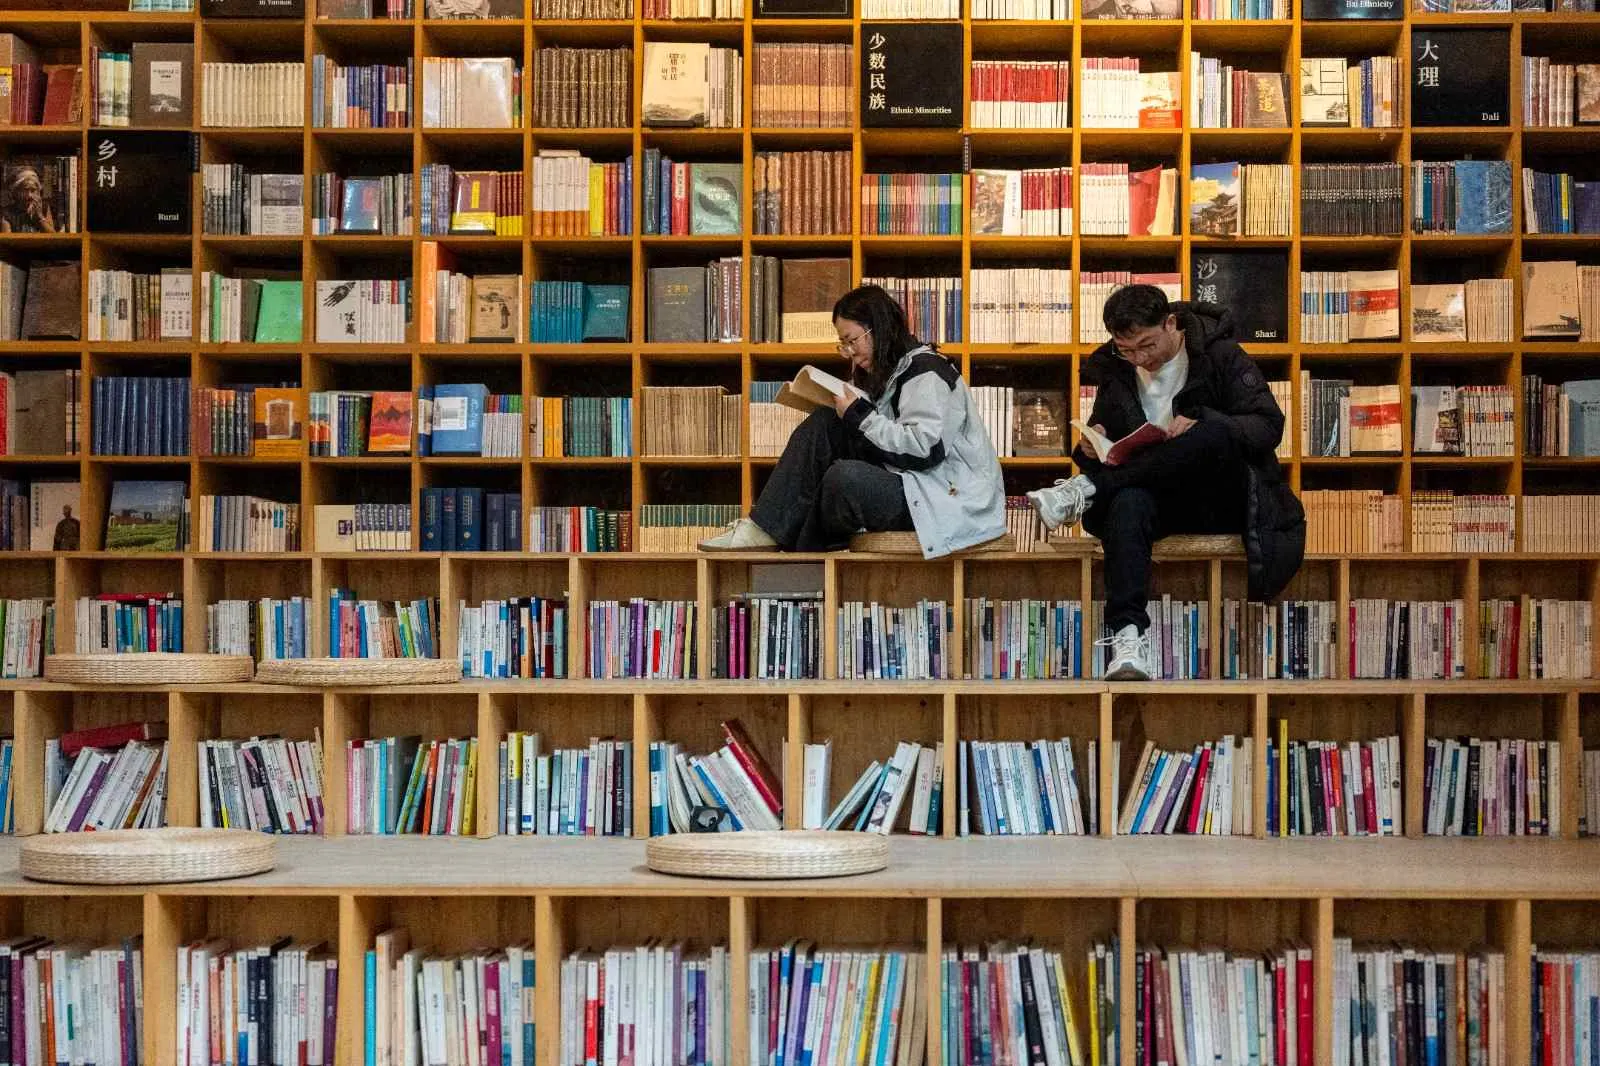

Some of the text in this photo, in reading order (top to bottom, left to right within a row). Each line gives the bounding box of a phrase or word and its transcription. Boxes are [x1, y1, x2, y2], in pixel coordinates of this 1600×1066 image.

[1359, 0, 1394, 9] Ethnicity
[1417, 39, 1440, 87] 大理
[868, 32, 886, 110] 少数民族
[890, 106, 952, 114] Ethnic Minorities
[1481, 112, 1500, 121] Dali
[96, 139, 119, 188] 乡村
[158, 213, 179, 221] Rural
[1196, 258, 1218, 304] 沙溪
[1255, 330, 1277, 338] Shaxi
